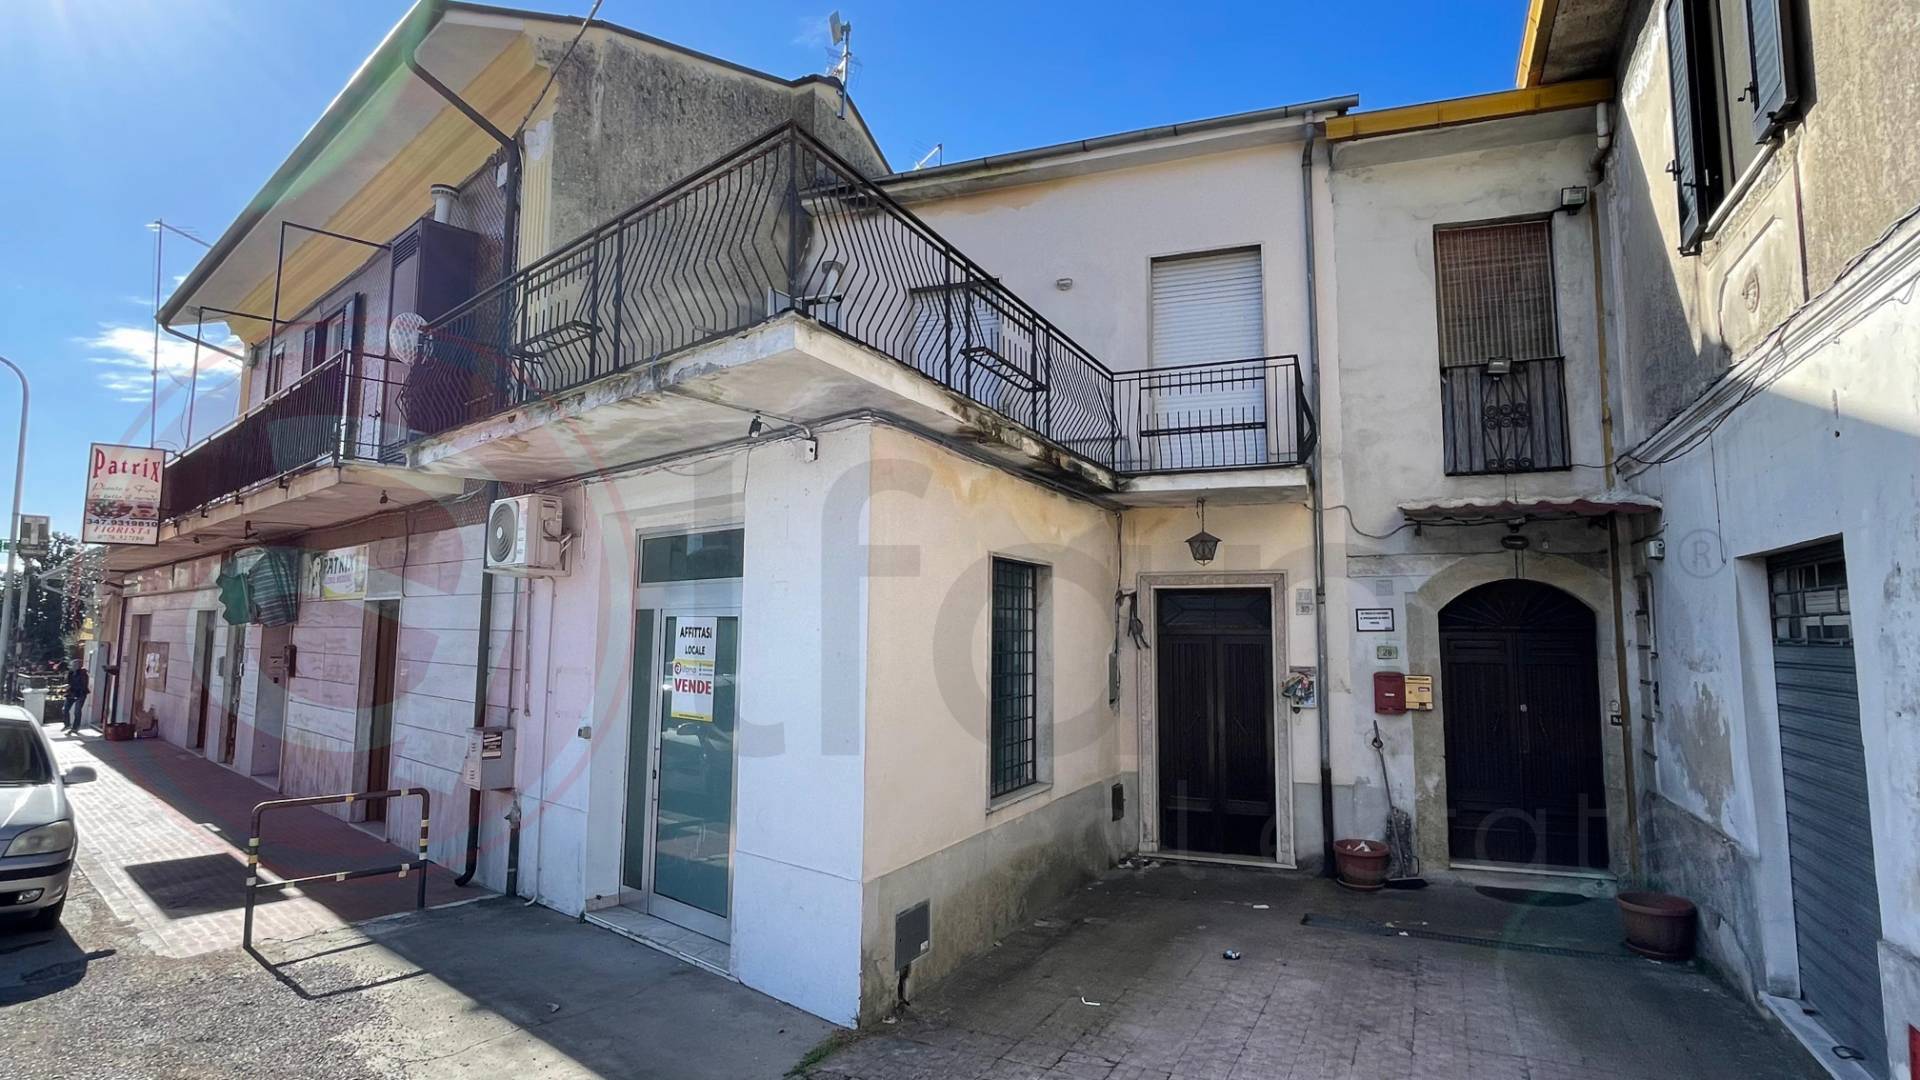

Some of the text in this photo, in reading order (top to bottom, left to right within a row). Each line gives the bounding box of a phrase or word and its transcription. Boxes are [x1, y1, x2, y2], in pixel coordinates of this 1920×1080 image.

[680, 626, 712, 639] AFFITTASI
[685, 645, 705, 656] LOCALE
[674, 678, 712, 695] VENDE
